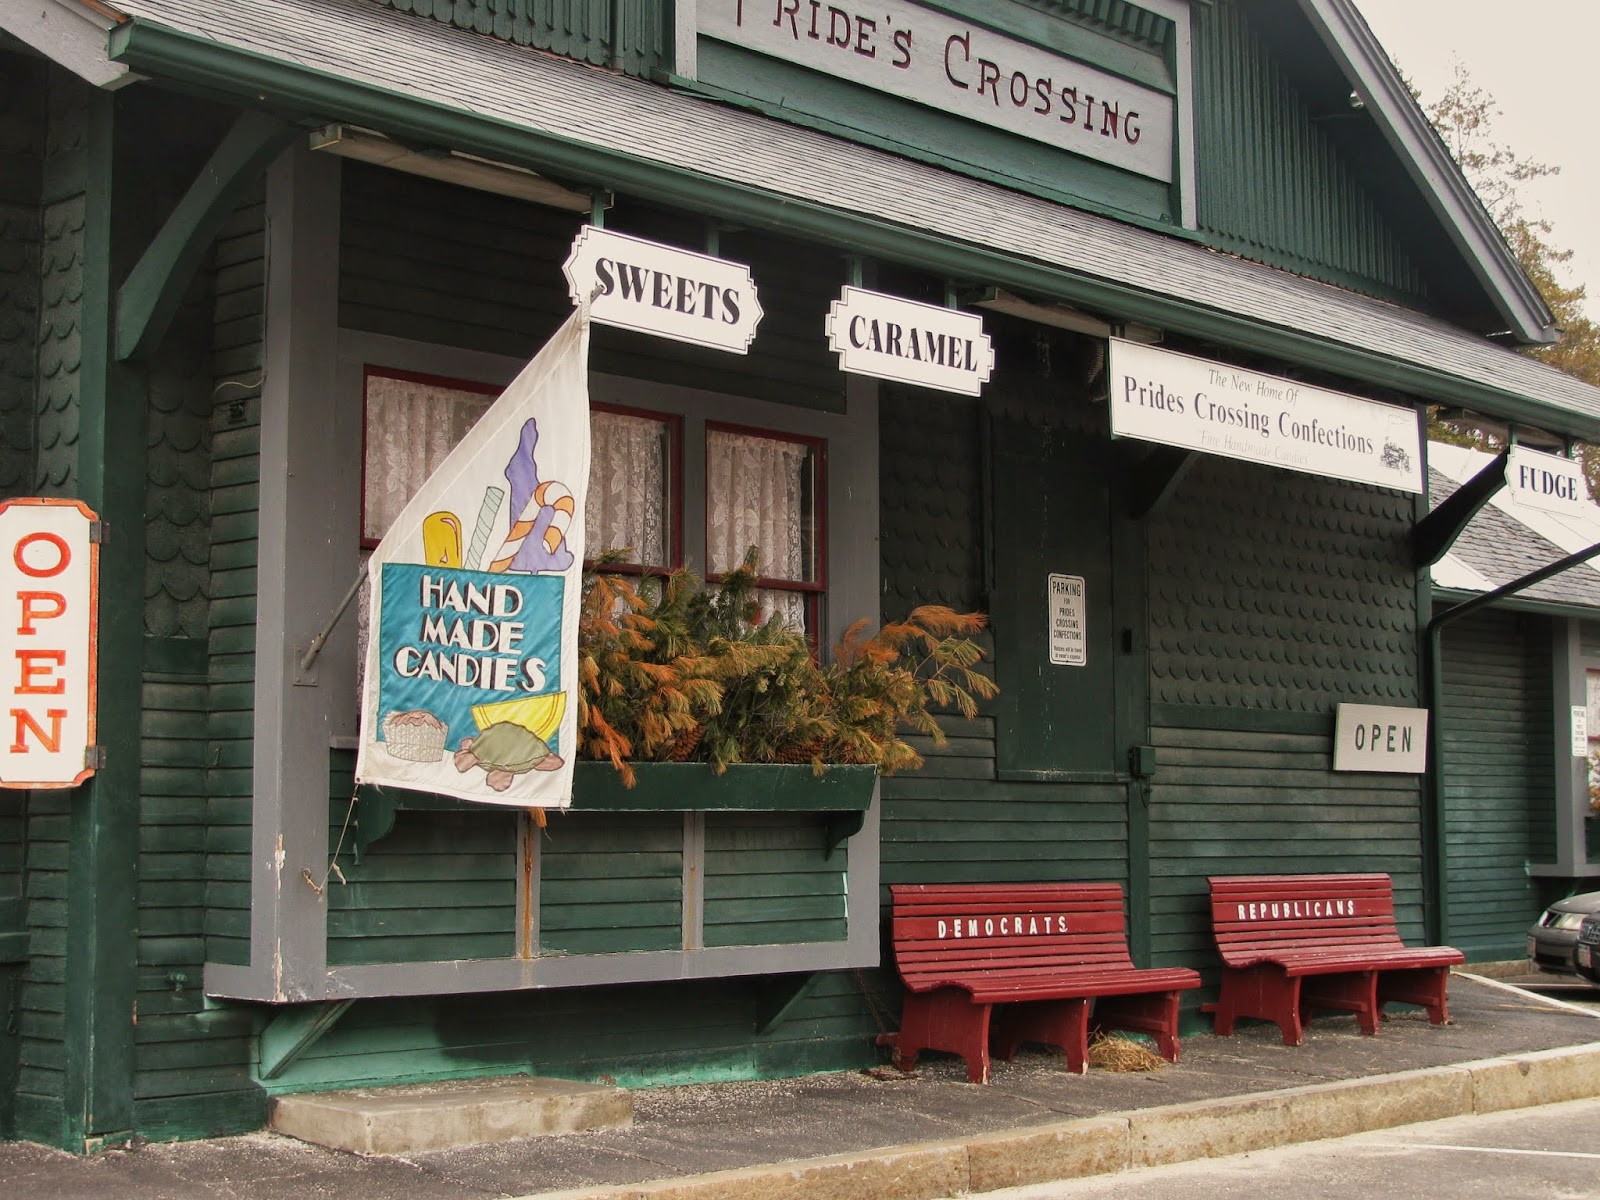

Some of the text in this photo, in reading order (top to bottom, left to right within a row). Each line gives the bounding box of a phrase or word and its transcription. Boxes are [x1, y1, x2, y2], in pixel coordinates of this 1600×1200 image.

[944, 31, 1142, 146] CROSSING
[595, 257, 740, 325] SWEETS
[848, 314, 979, 373] CARAMEL
[1208, 368, 1300, 407] The New Home Of
[1123, 375, 1374, 455] Prides Crossing Confections
[1519, 464, 1578, 502] FUDGE
[419, 574, 524, 617] HAND
[1052, 581, 1081, 597] PARKING
[1055, 618, 1079, 629] CROSSING
[1059, 607, 1076, 618] PRIDES
[9, 531, 72, 754] OPEN
[419, 613, 525, 655] MADE
[1053, 629, 1082, 641] CONFECTIONS
[393, 646, 547, 693] CANDIES
[1354, 723, 1412, 753] OPEN
[936, 914, 1069, 939] DEMOCRATS
[1236, 898, 1357, 921] REPUBLICANS
